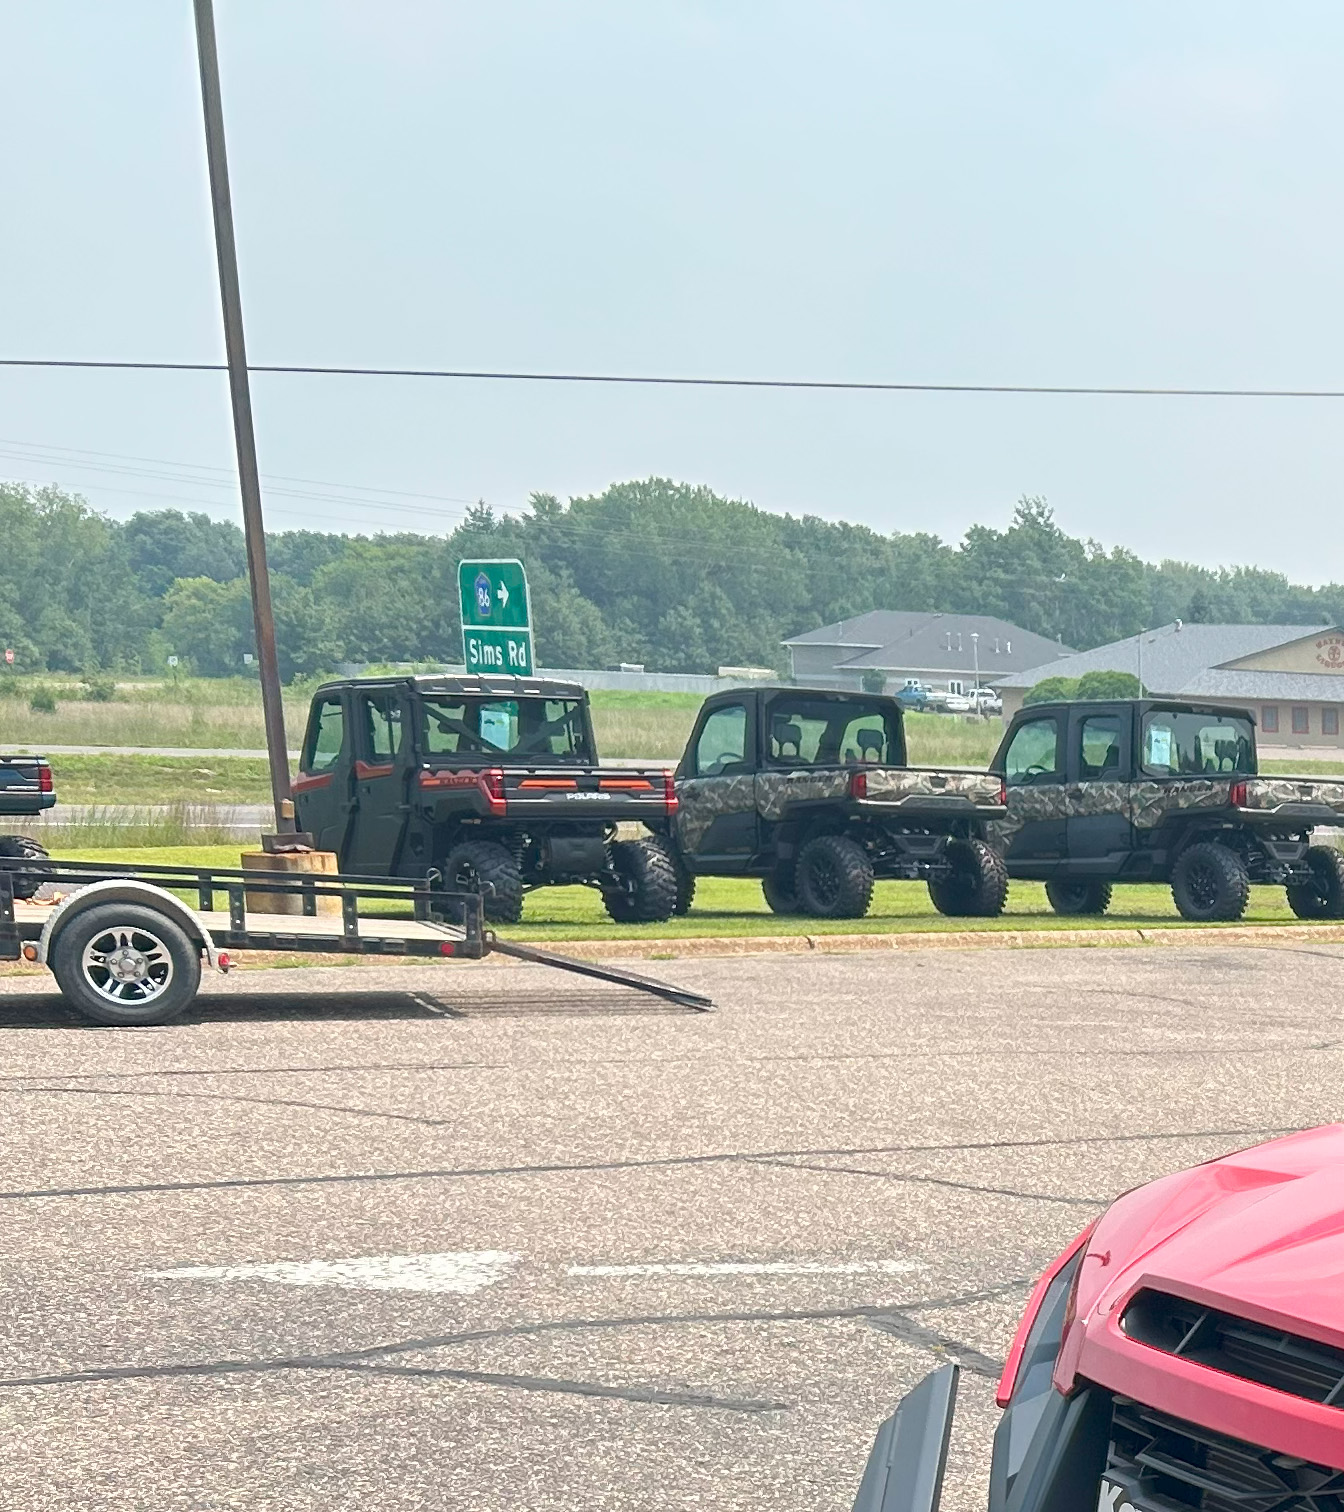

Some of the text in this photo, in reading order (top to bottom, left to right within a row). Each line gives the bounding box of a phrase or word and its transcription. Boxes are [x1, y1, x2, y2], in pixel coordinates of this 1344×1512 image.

[478, 587, 490, 607] 86
[469, 639, 527, 667] Sims Rd
